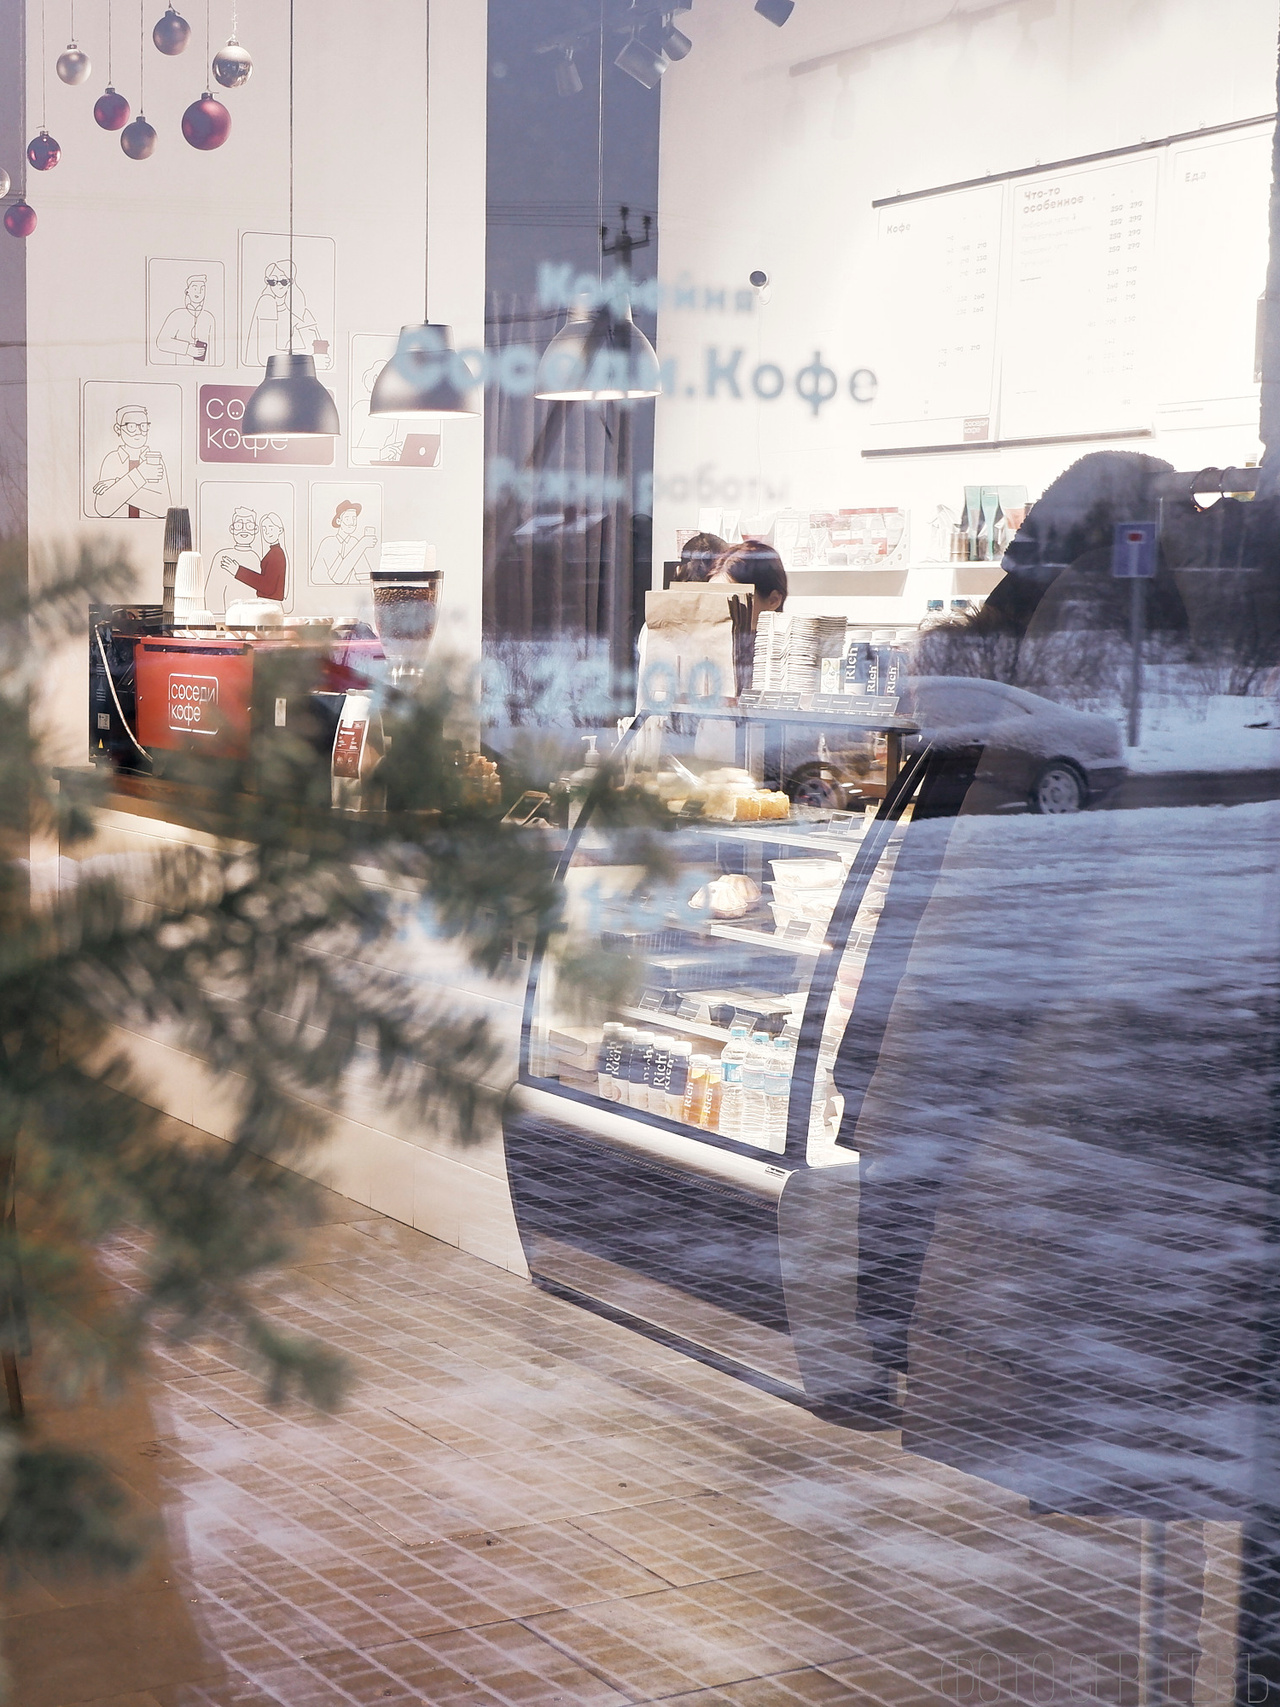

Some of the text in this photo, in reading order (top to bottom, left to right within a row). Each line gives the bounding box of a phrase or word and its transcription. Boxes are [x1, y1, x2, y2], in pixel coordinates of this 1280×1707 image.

[1185, 171, 1207, 183] Еда
[1023, 195, 1084, 214] особенное
[1024, 187, 1061, 200] Что-то
[886, 222, 911, 234] Кофе
[845, 647, 858, 680] Rich
[867, 665, 877, 693] Rich
[887, 666, 897, 694] Rich
[171, 684, 216, 705] соседи
[171, 703, 201, 726] кофе
[653, 1053, 667, 1087] Rich
[684, 1082, 694, 1108] Rich
[703, 1088, 714, 1114] Rich
